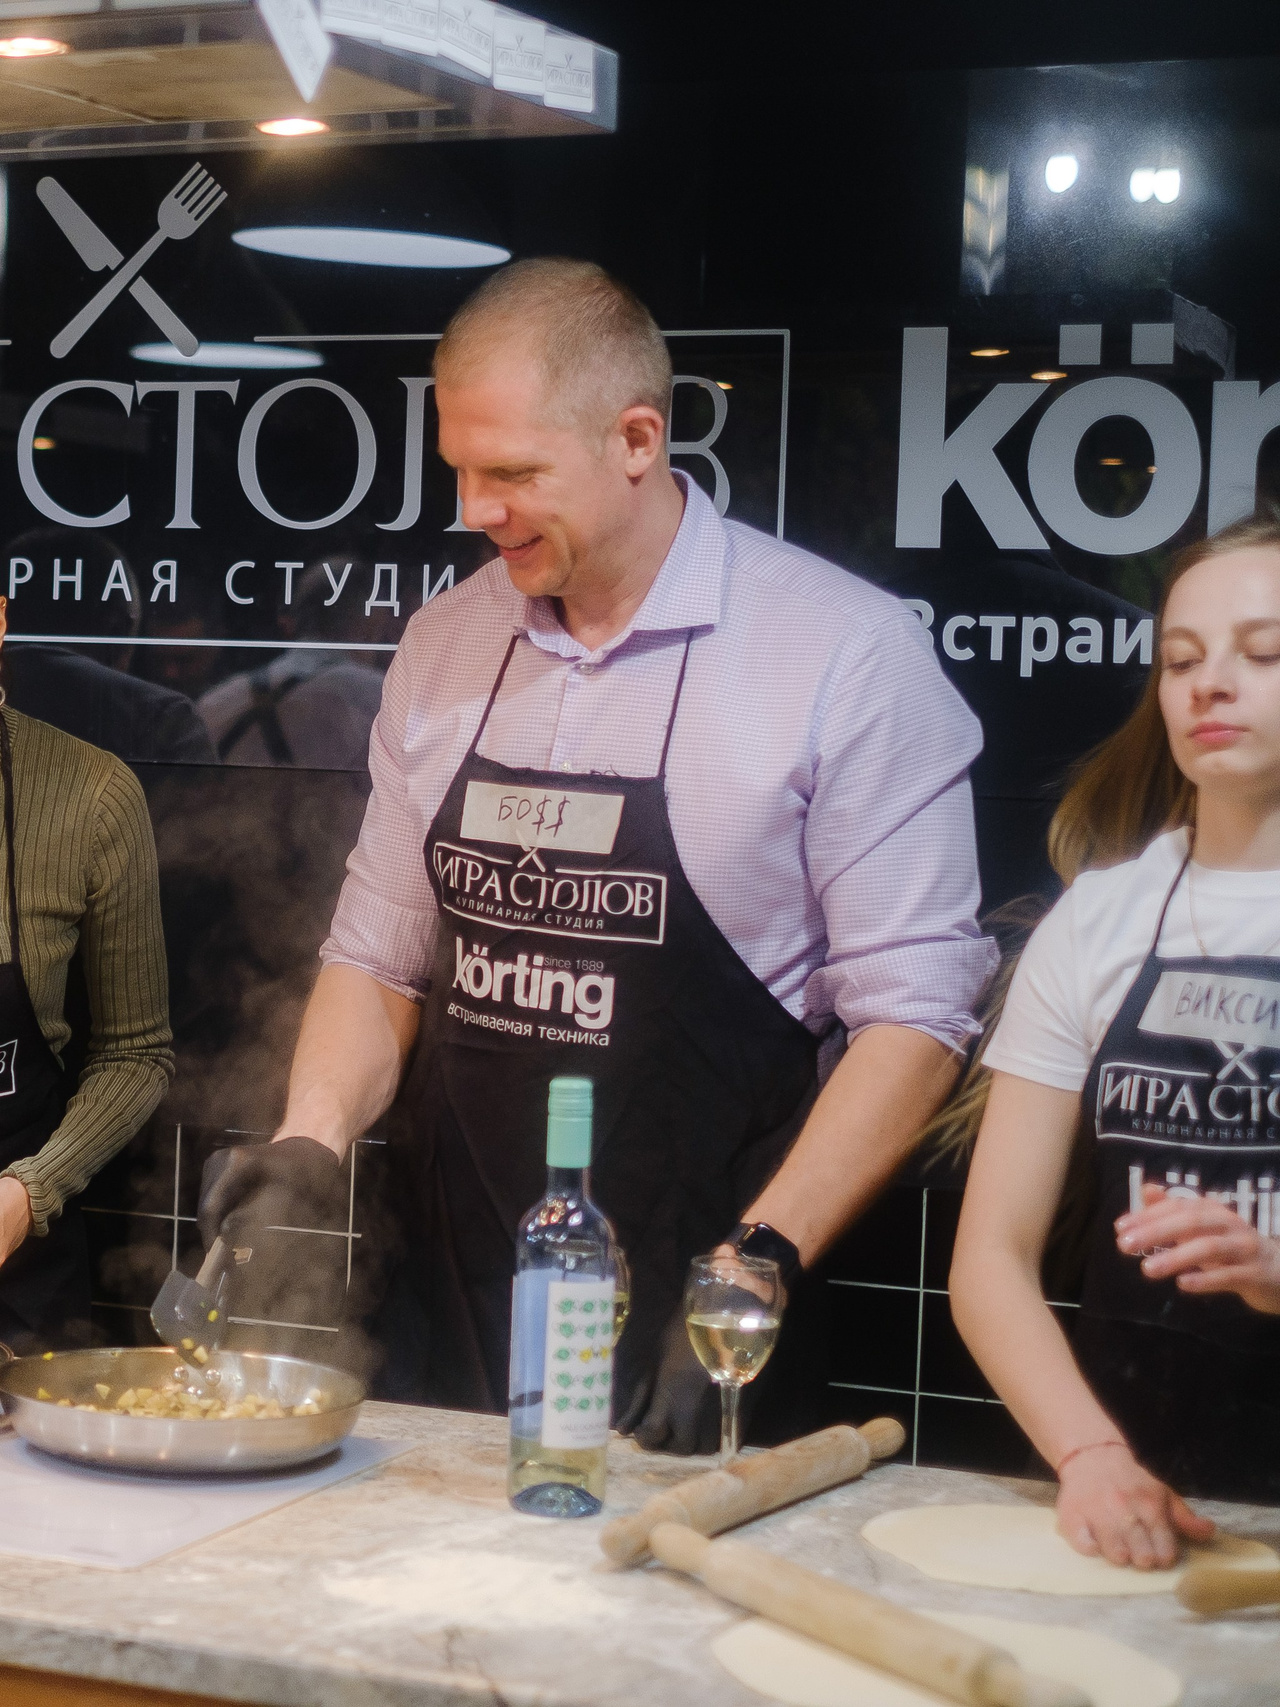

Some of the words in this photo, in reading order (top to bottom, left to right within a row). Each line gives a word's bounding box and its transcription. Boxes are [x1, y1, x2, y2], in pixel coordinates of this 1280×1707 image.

[16, 376, 731, 532] СТОЛВ
[225, 560, 455, 617] СТУДИ
[437, 851, 502, 901] ИГРА
[509, 872, 654, 917] СТОЛОВ
[544, 913, 604, 930] СТУДИЯ
[452, 937, 616, 1029] körting
[544, 955, 571, 970] since
[575, 957, 604, 973] 1889
[447, 1001, 532, 1038] встраиваемая
[537, 1023, 610, 1047] техника
[1102, 1072, 1200, 1121] ИГРА
[1131, 1117, 1256, 1140] КУЛИНАРНАЯ
